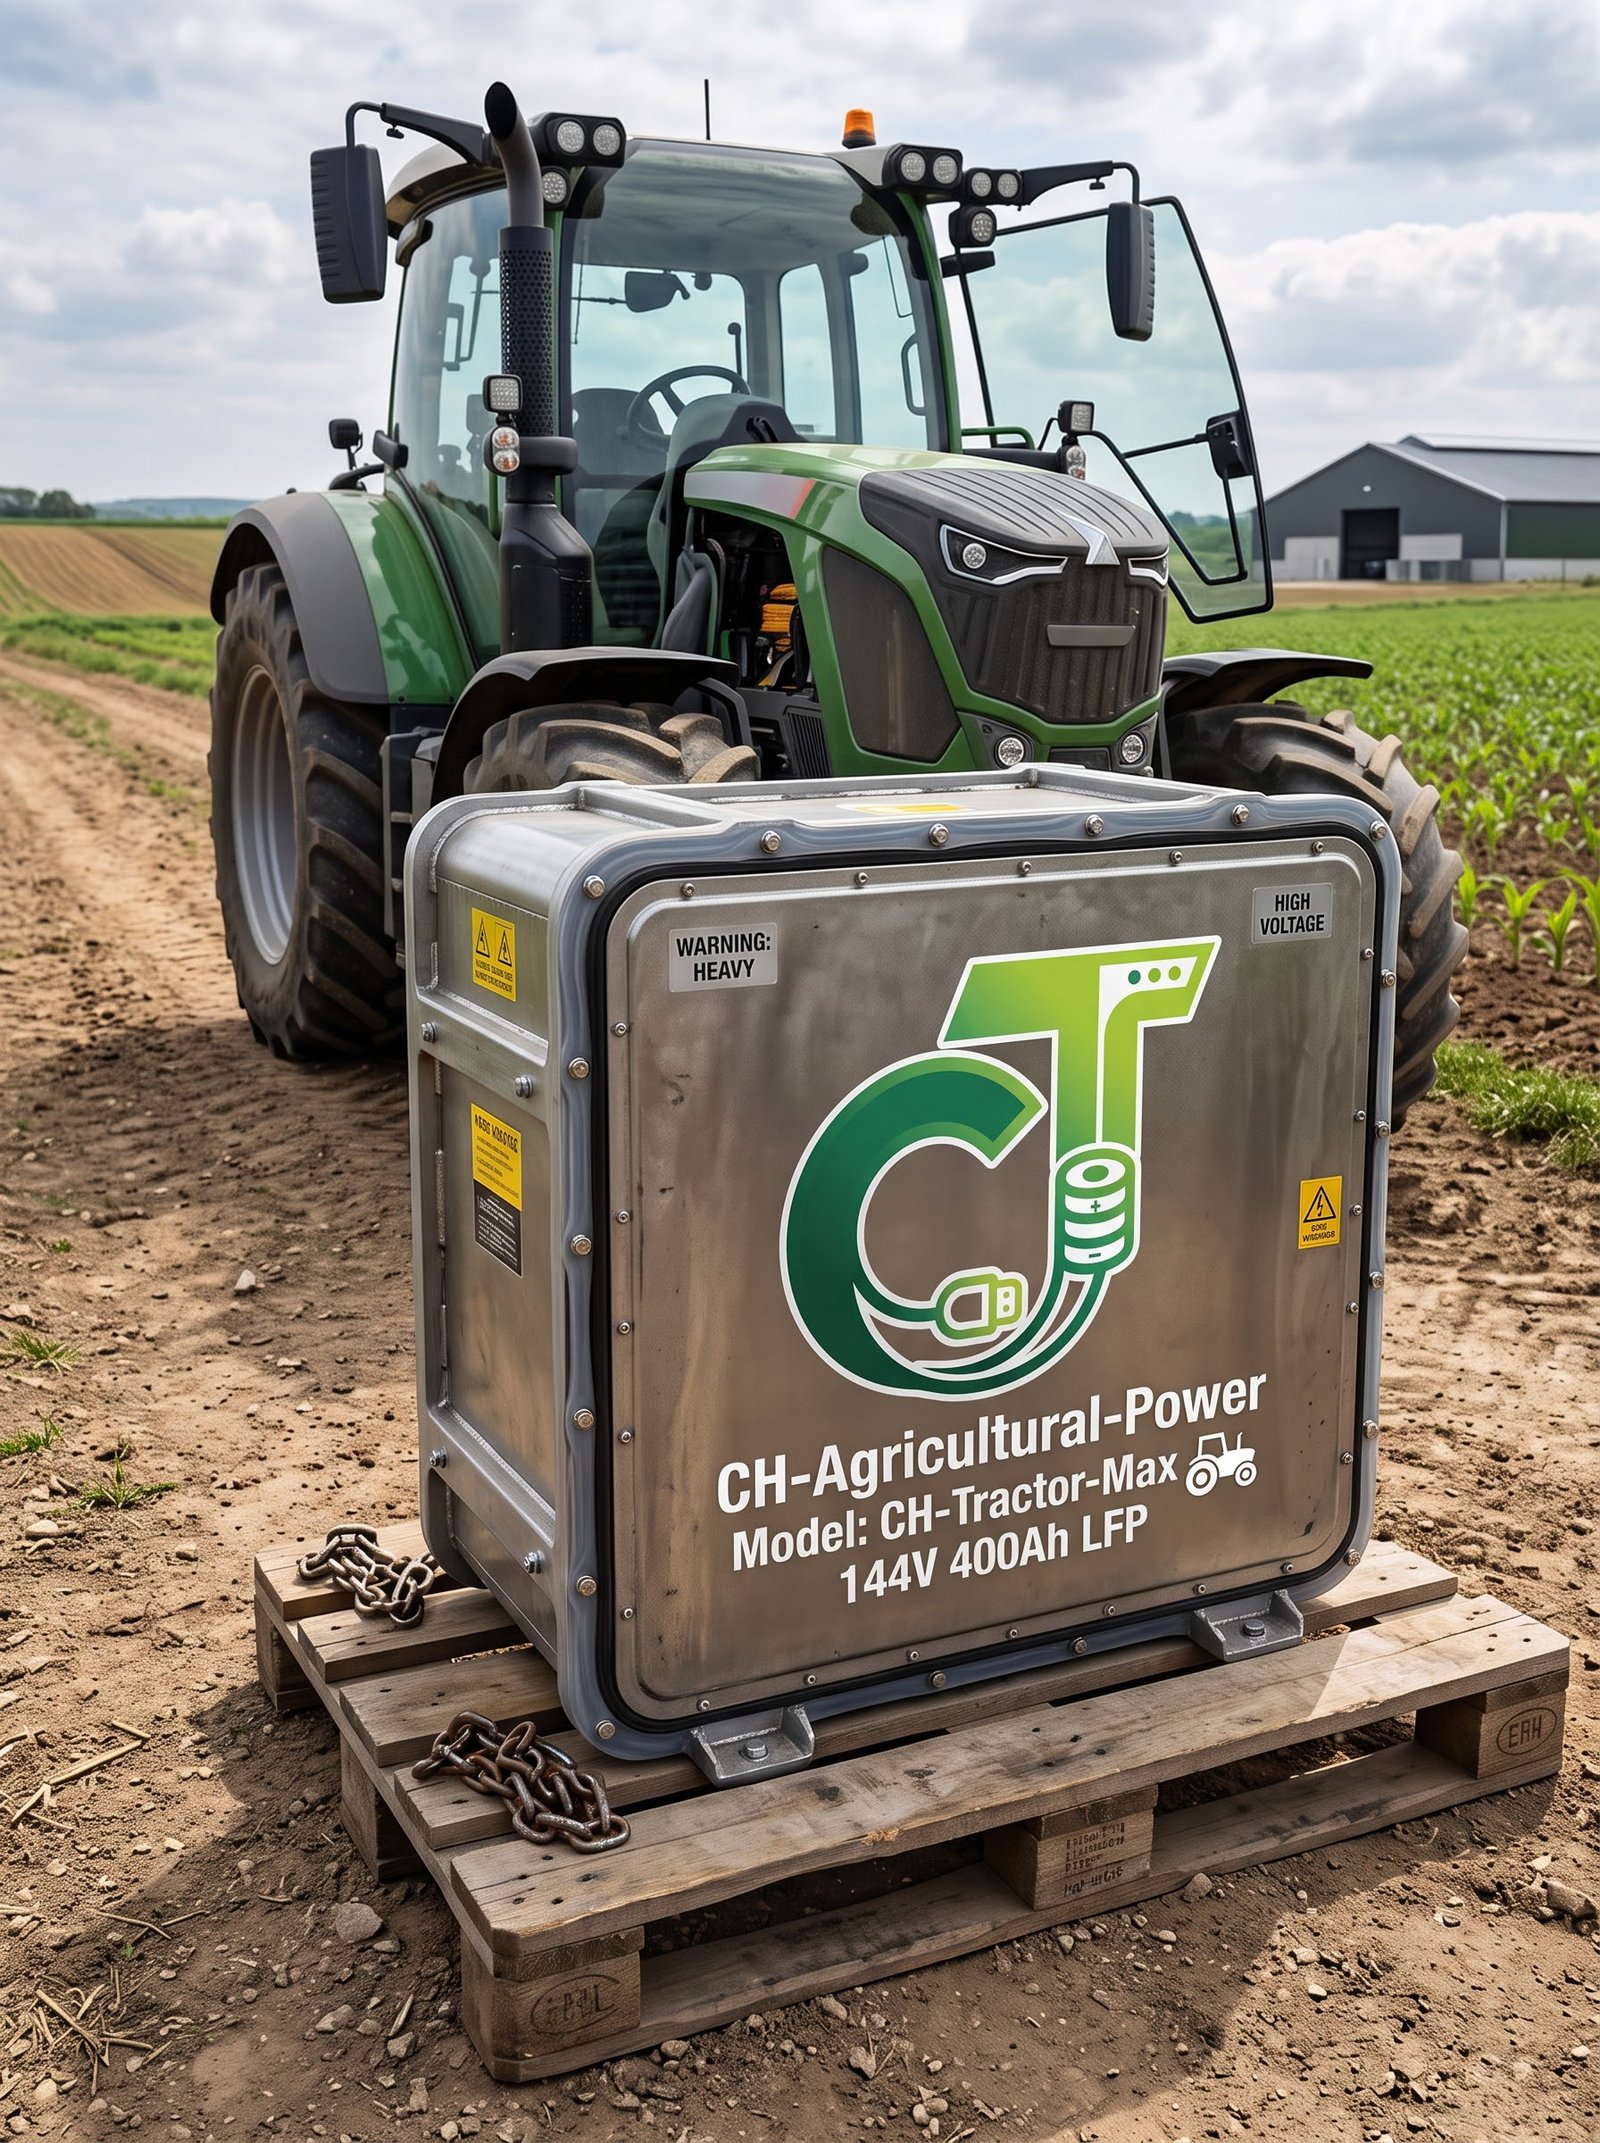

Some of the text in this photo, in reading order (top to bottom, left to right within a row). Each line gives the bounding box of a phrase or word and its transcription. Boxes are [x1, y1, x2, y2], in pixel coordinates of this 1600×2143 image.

[1275, 892, 1311, 912] HIGH
[1260, 914, 1325, 936] VOLTAGE
[676, 932, 771, 957] WARNING:
[693, 958, 755, 982] HEAVY
[717, 1373, 1267, 1514] CH-Agricultural-Power
[733, 1449, 1179, 1571] Model: CH-Tractor-Max
[840, 1503, 1149, 1604] 144V 400Ah LFP
